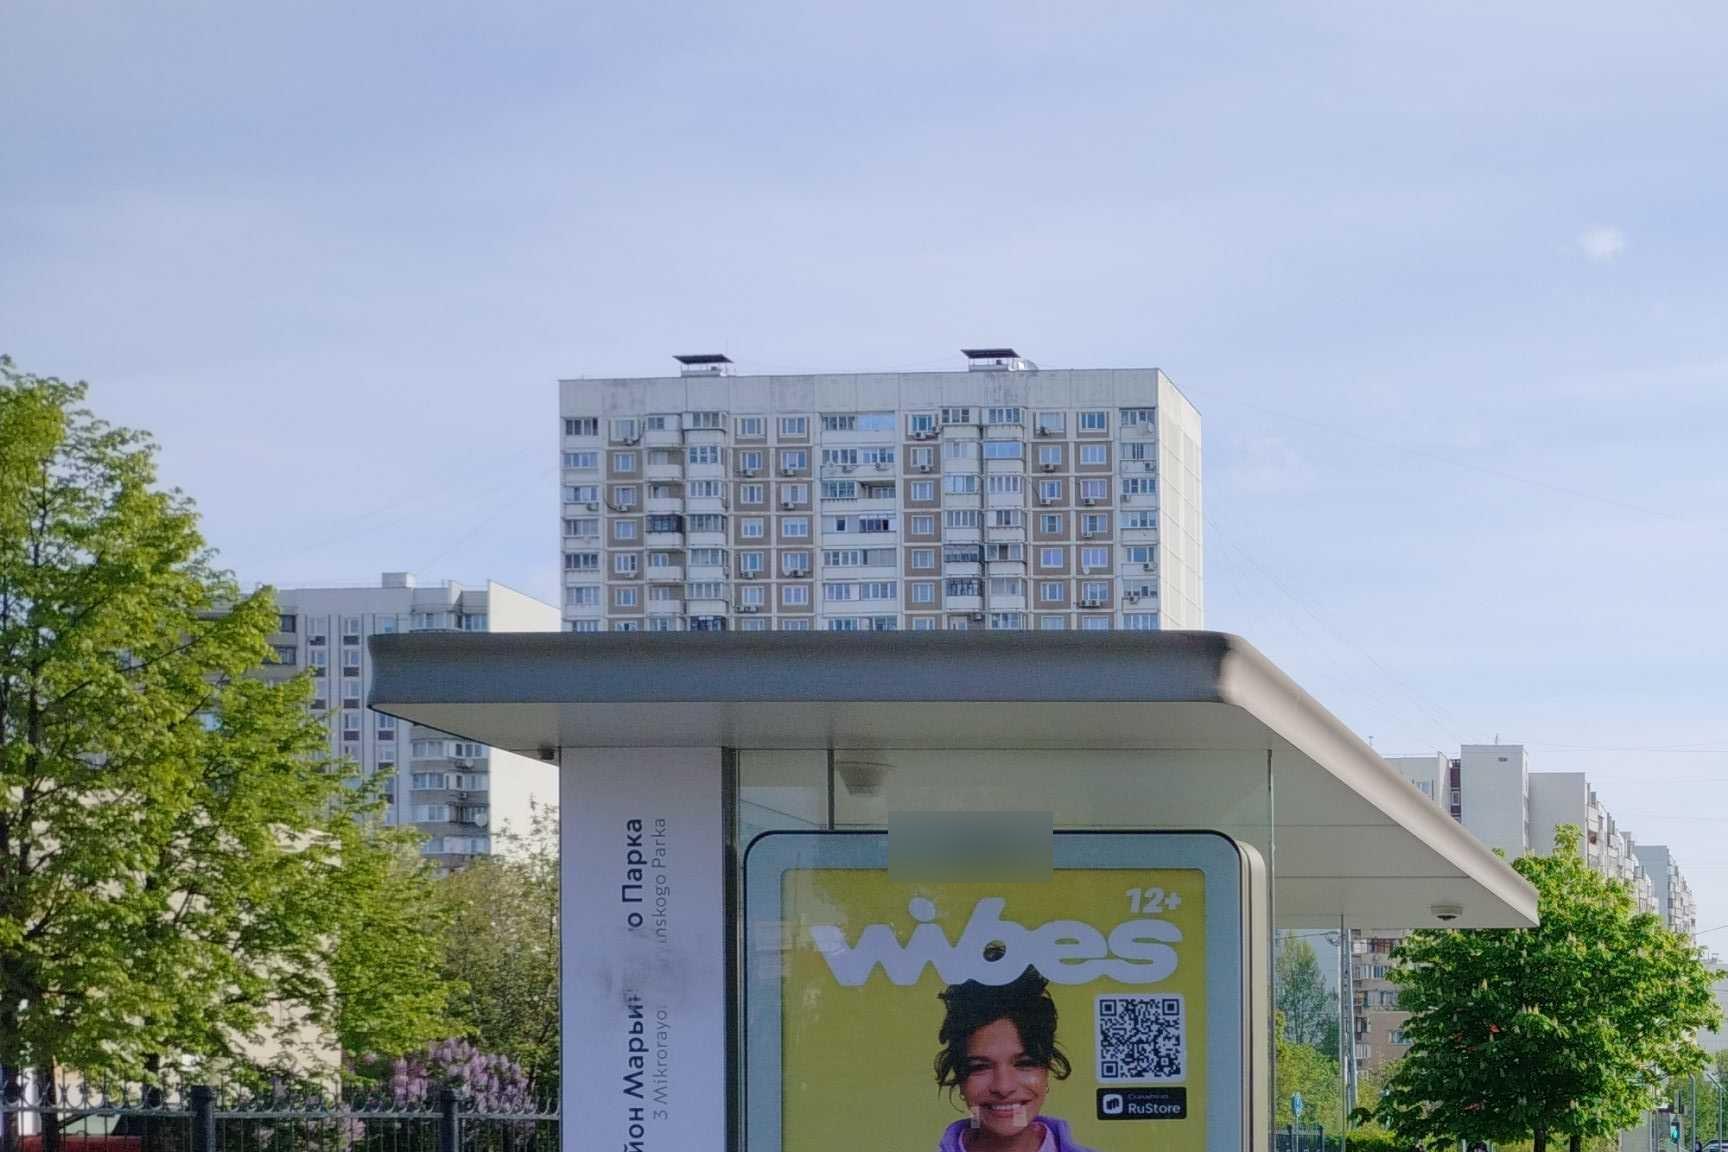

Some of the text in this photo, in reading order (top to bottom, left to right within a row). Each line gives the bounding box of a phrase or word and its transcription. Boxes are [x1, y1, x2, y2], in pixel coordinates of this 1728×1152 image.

[622, 817, 648, 903] Парка
[651, 817, 668, 868] Parka
[1125, 887, 1182, 914] 12+
[811, 896, 1183, 987] wibes
[653, 1109, 668, 1120] 3
[1128, 1102, 1182, 1114] RuStore
